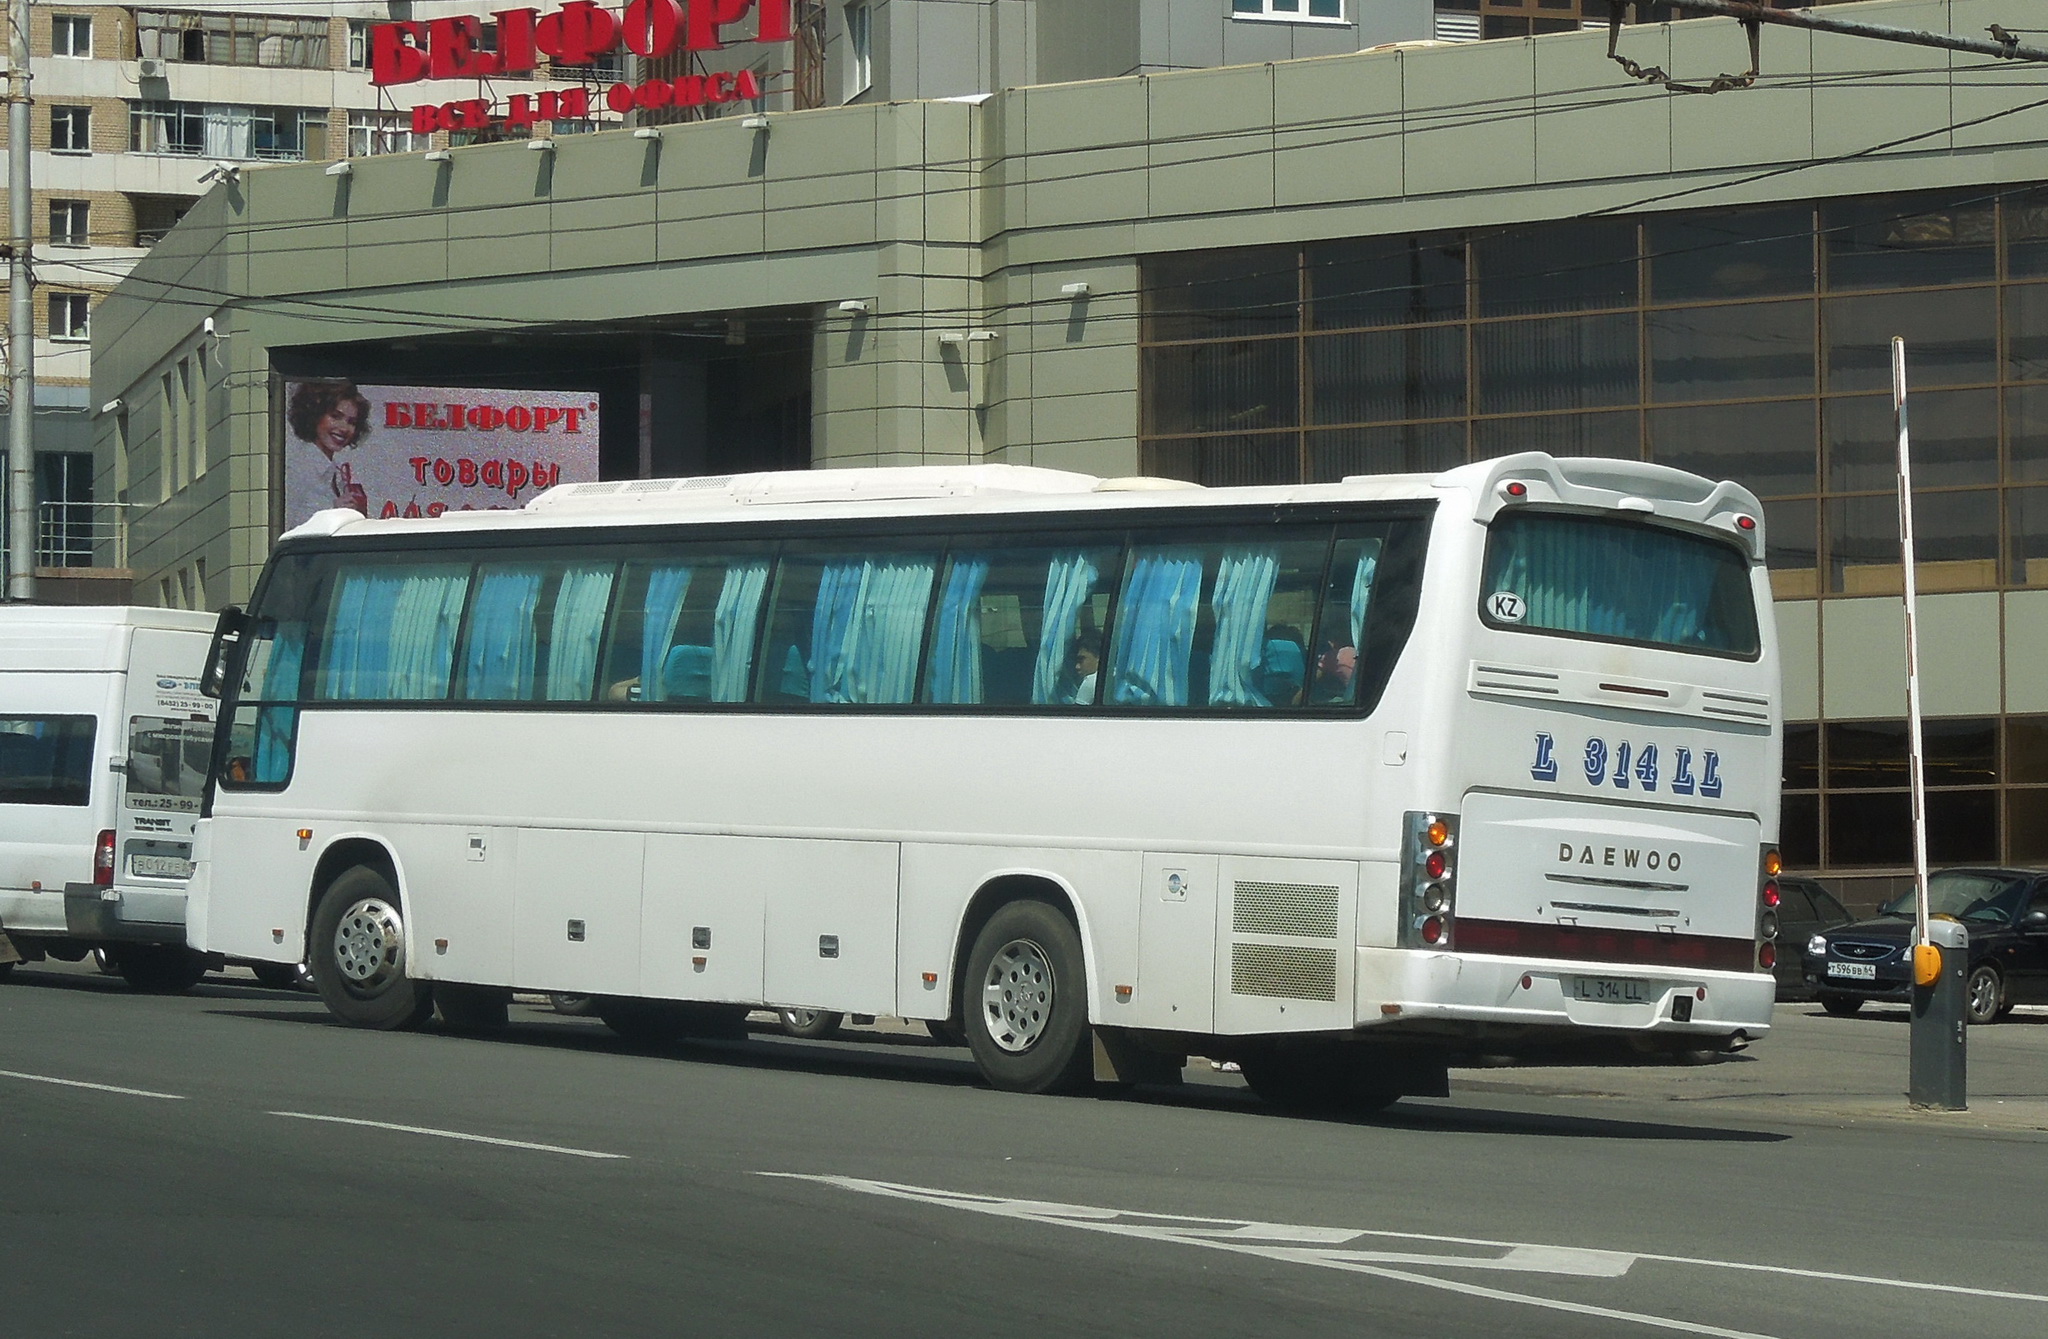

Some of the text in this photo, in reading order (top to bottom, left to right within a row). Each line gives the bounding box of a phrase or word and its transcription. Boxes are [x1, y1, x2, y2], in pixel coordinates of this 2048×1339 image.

[370, 0, 795, 86] БЕЛФОРТ
[411, 69, 760, 134] ВСЕ ДЛЯ ОФИСА
[384, 402, 585, 433] БЕЛФОРТ
[408, 456, 560, 499] товары
[1495, 596, 1517, 617] KZ
[1532, 732, 1722, 798] L 314 LL
[134, 817, 171, 826] TRANSIT
[1558, 843, 1682, 872] DAEWOO
[1582, 980, 1642, 1000] L 314 LL
